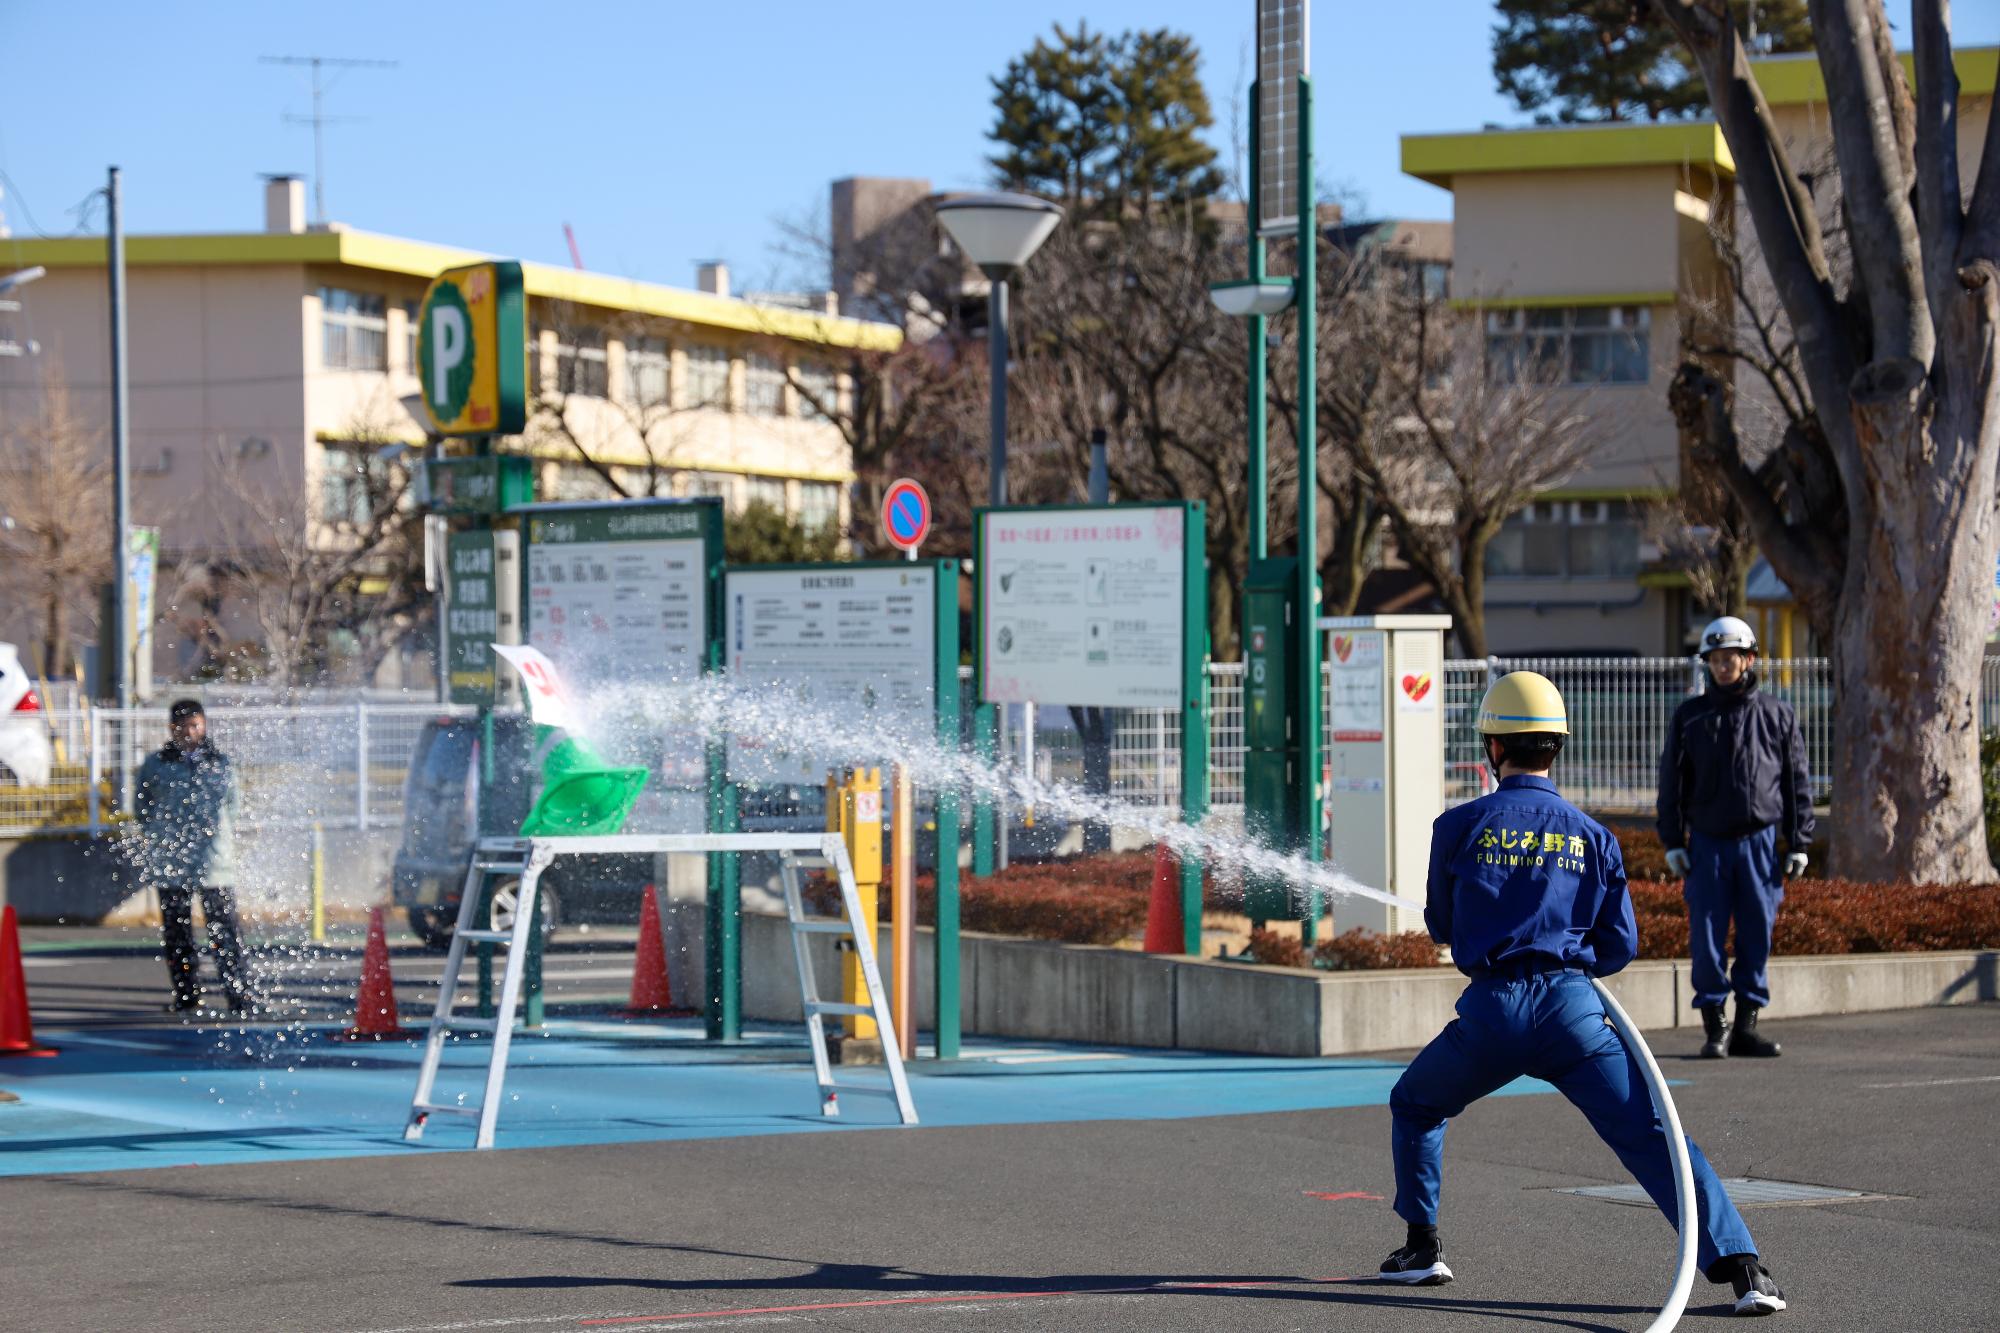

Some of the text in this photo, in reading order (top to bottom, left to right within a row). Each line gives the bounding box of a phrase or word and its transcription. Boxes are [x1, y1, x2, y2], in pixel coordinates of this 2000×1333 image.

[432, 304, 466, 406] P
[1477, 828, 1587, 858] ふじみ野市
[1477, 853, 1586, 874] FUJIMINO CITY
